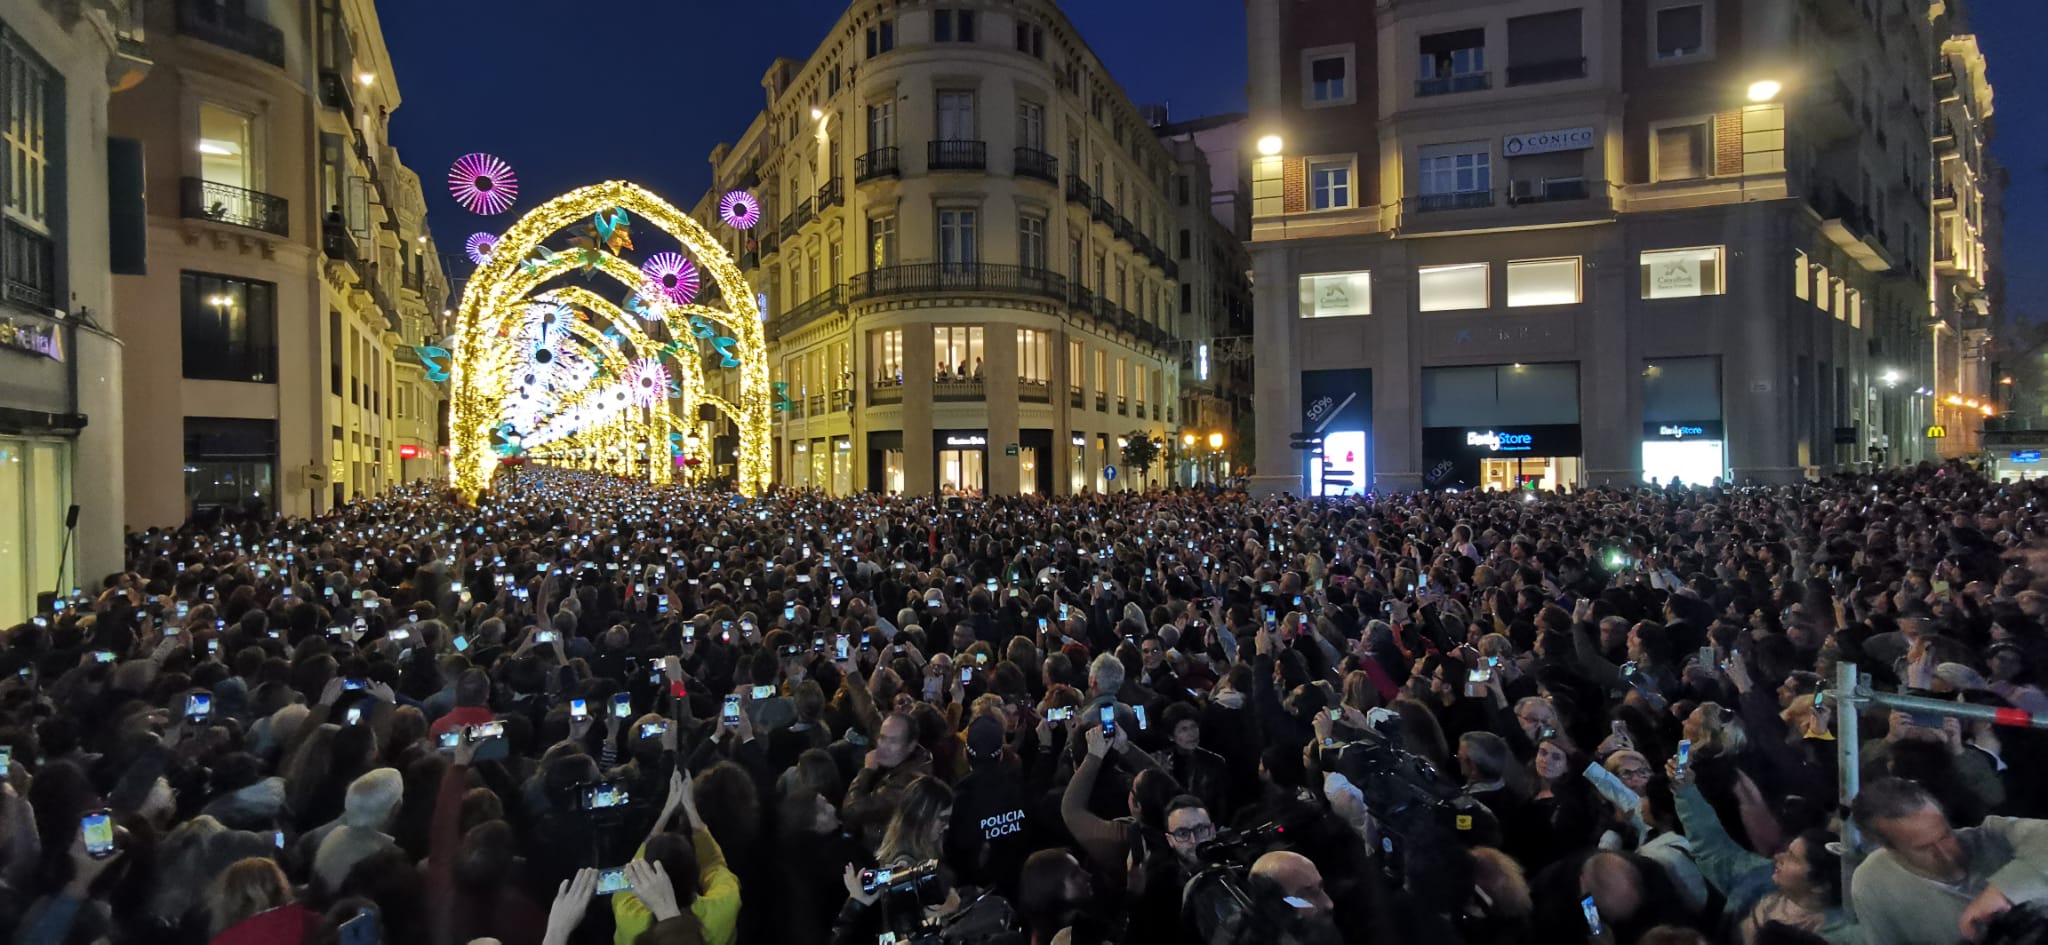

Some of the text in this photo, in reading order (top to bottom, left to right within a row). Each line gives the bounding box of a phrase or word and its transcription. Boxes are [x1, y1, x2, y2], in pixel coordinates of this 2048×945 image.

[1306, 395, 1333, 420] 50%
[980, 809, 1025, 829] POLICIA
[985, 821, 1021, 839] LOCAL
